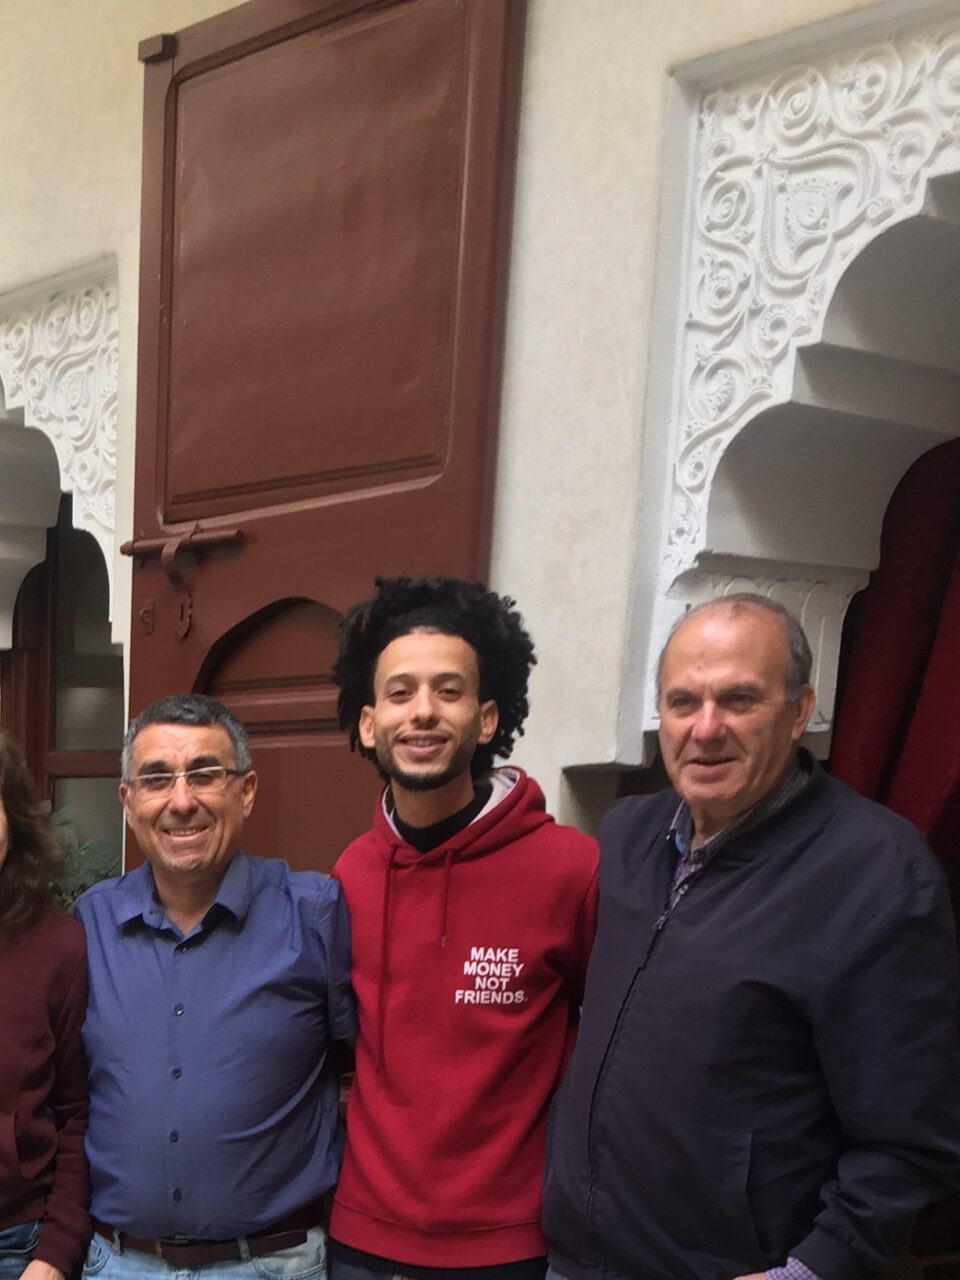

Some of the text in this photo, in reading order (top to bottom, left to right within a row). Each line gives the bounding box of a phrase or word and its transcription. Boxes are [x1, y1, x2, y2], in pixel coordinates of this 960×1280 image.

[470, 946, 519, 962] MAKE
[463, 961, 524, 977] MONEY
[475, 976, 510, 990] NOT
